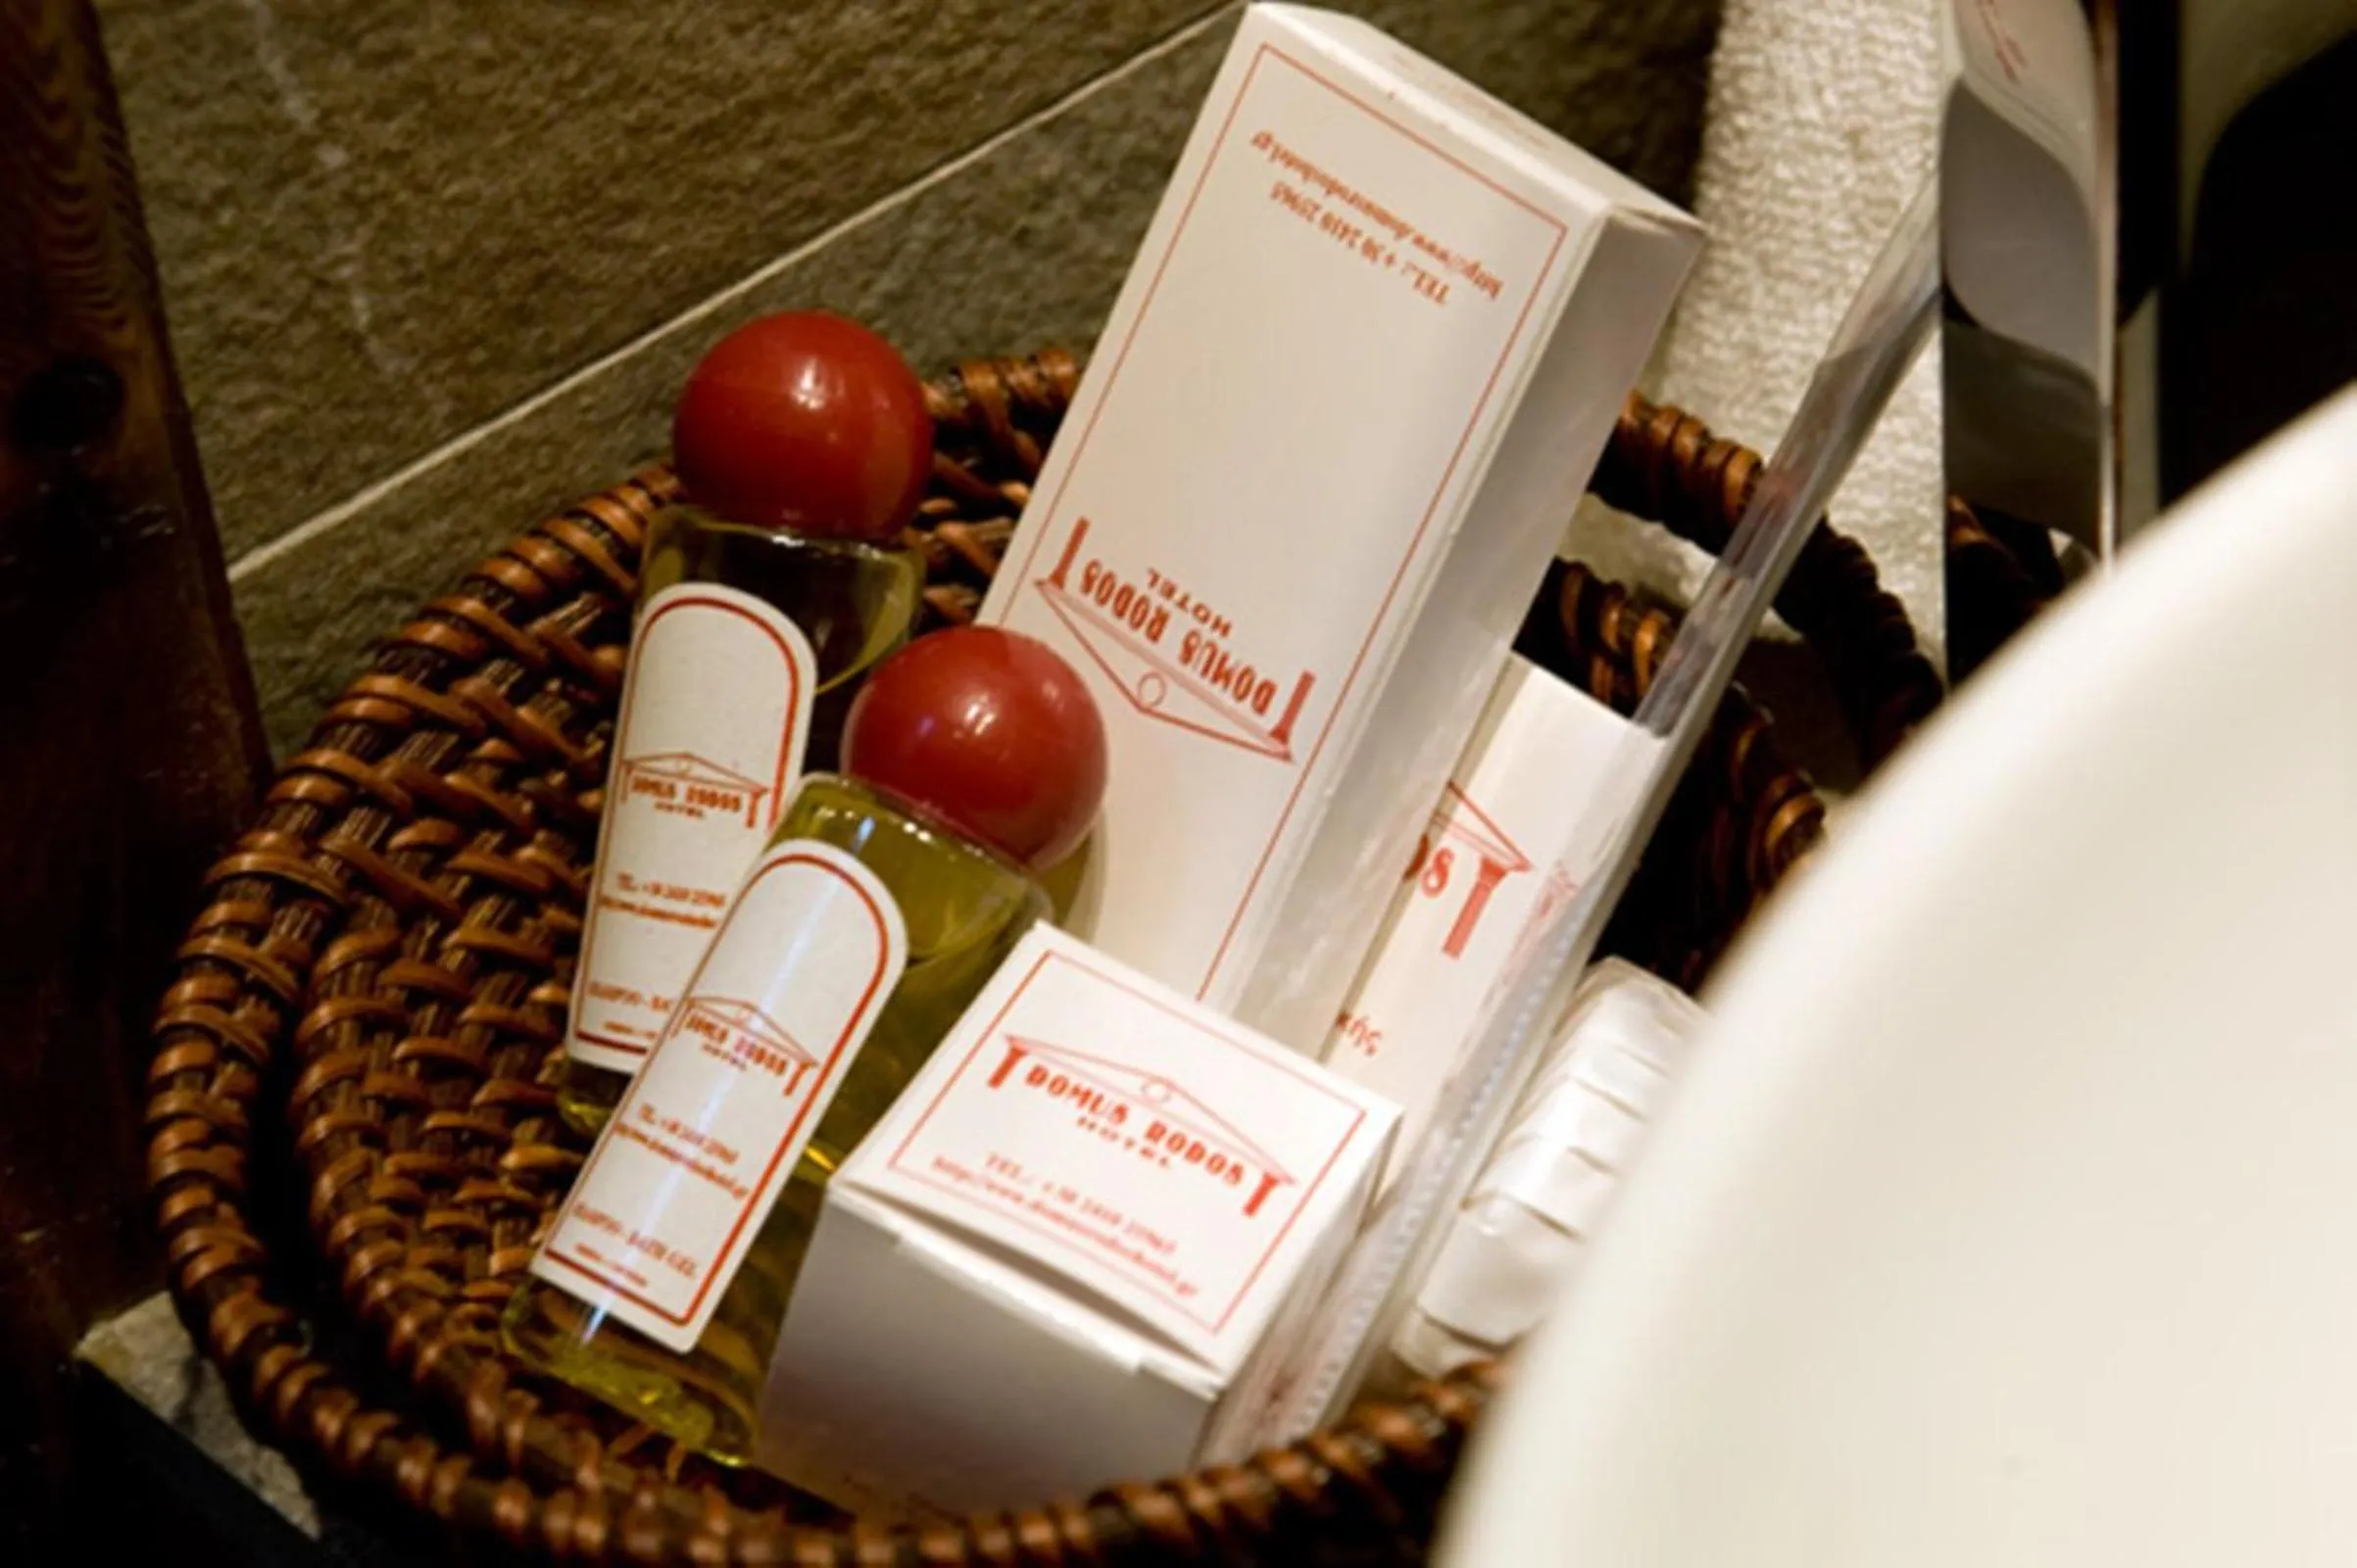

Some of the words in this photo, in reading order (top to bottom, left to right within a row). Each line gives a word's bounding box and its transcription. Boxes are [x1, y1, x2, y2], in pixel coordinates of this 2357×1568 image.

[1079, 558, 1170, 645] RODOS
[1146, 565, 1233, 638] HOTEL
[1178, 627, 1278, 716] DOMUS
[1024, 1063, 1130, 1126] DOMUS
[1143, 1118, 1247, 1188] RODOS
[1075, 1115, 1172, 1170] HOTEL
